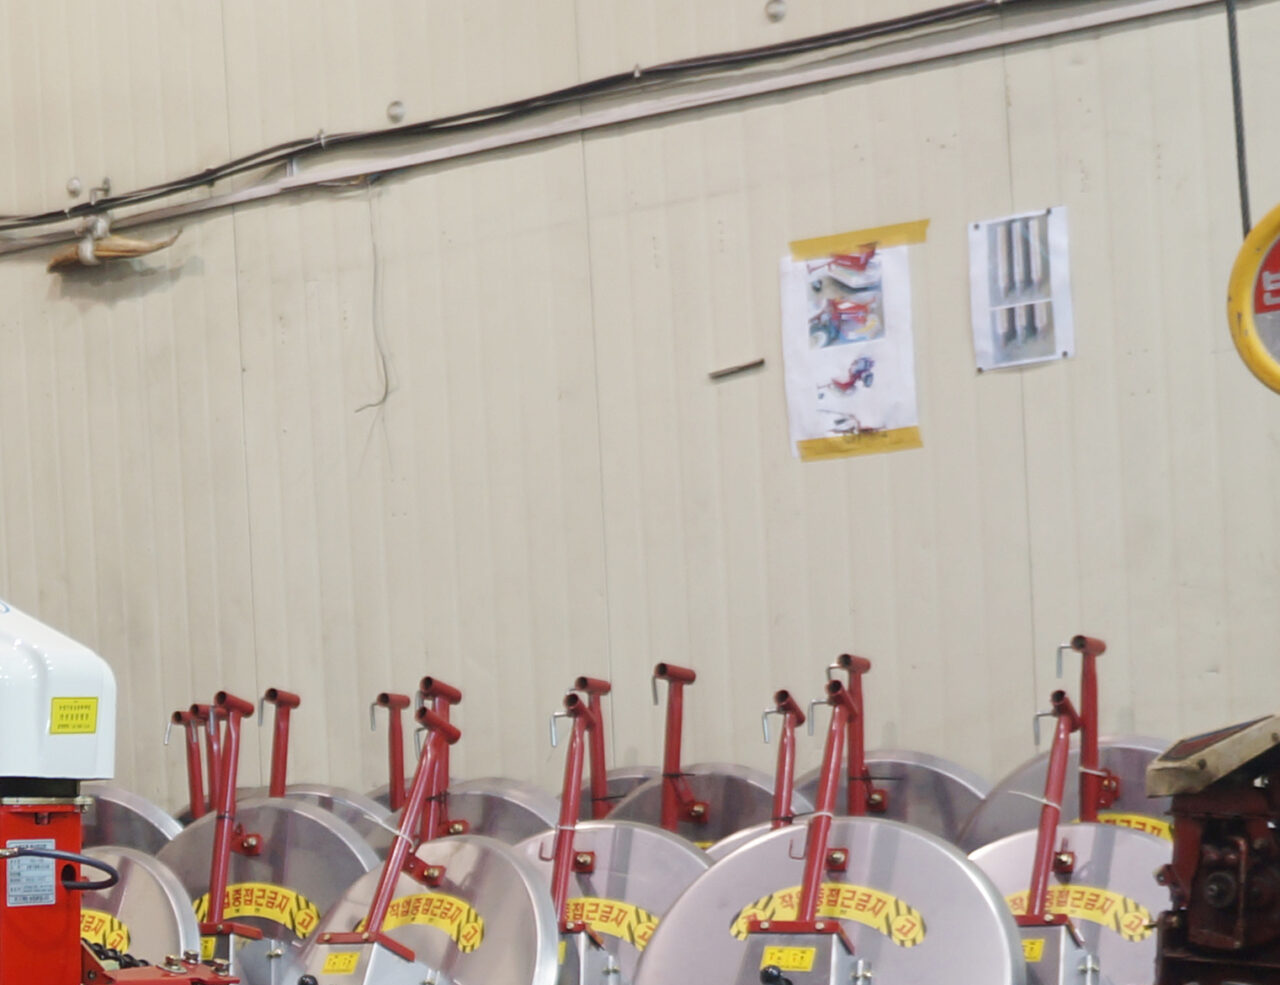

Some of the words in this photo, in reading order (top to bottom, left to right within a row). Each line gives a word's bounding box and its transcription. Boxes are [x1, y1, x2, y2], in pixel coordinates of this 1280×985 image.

[223, 888, 290, 914] 업중접근금지
[298, 912, 314, 930] 고
[389, 898, 462, 924] 작업중접근금지
[463, 926, 478, 942] 고
[779, 887, 887, 918] 작접근금지
[896, 918, 916, 937] 고
[1010, 890, 1115, 914] 작중접근금지
[1124, 915, 1142, 932] 고
[81, 914, 105, 936] 금지
[109, 932, 124, 949] 고
